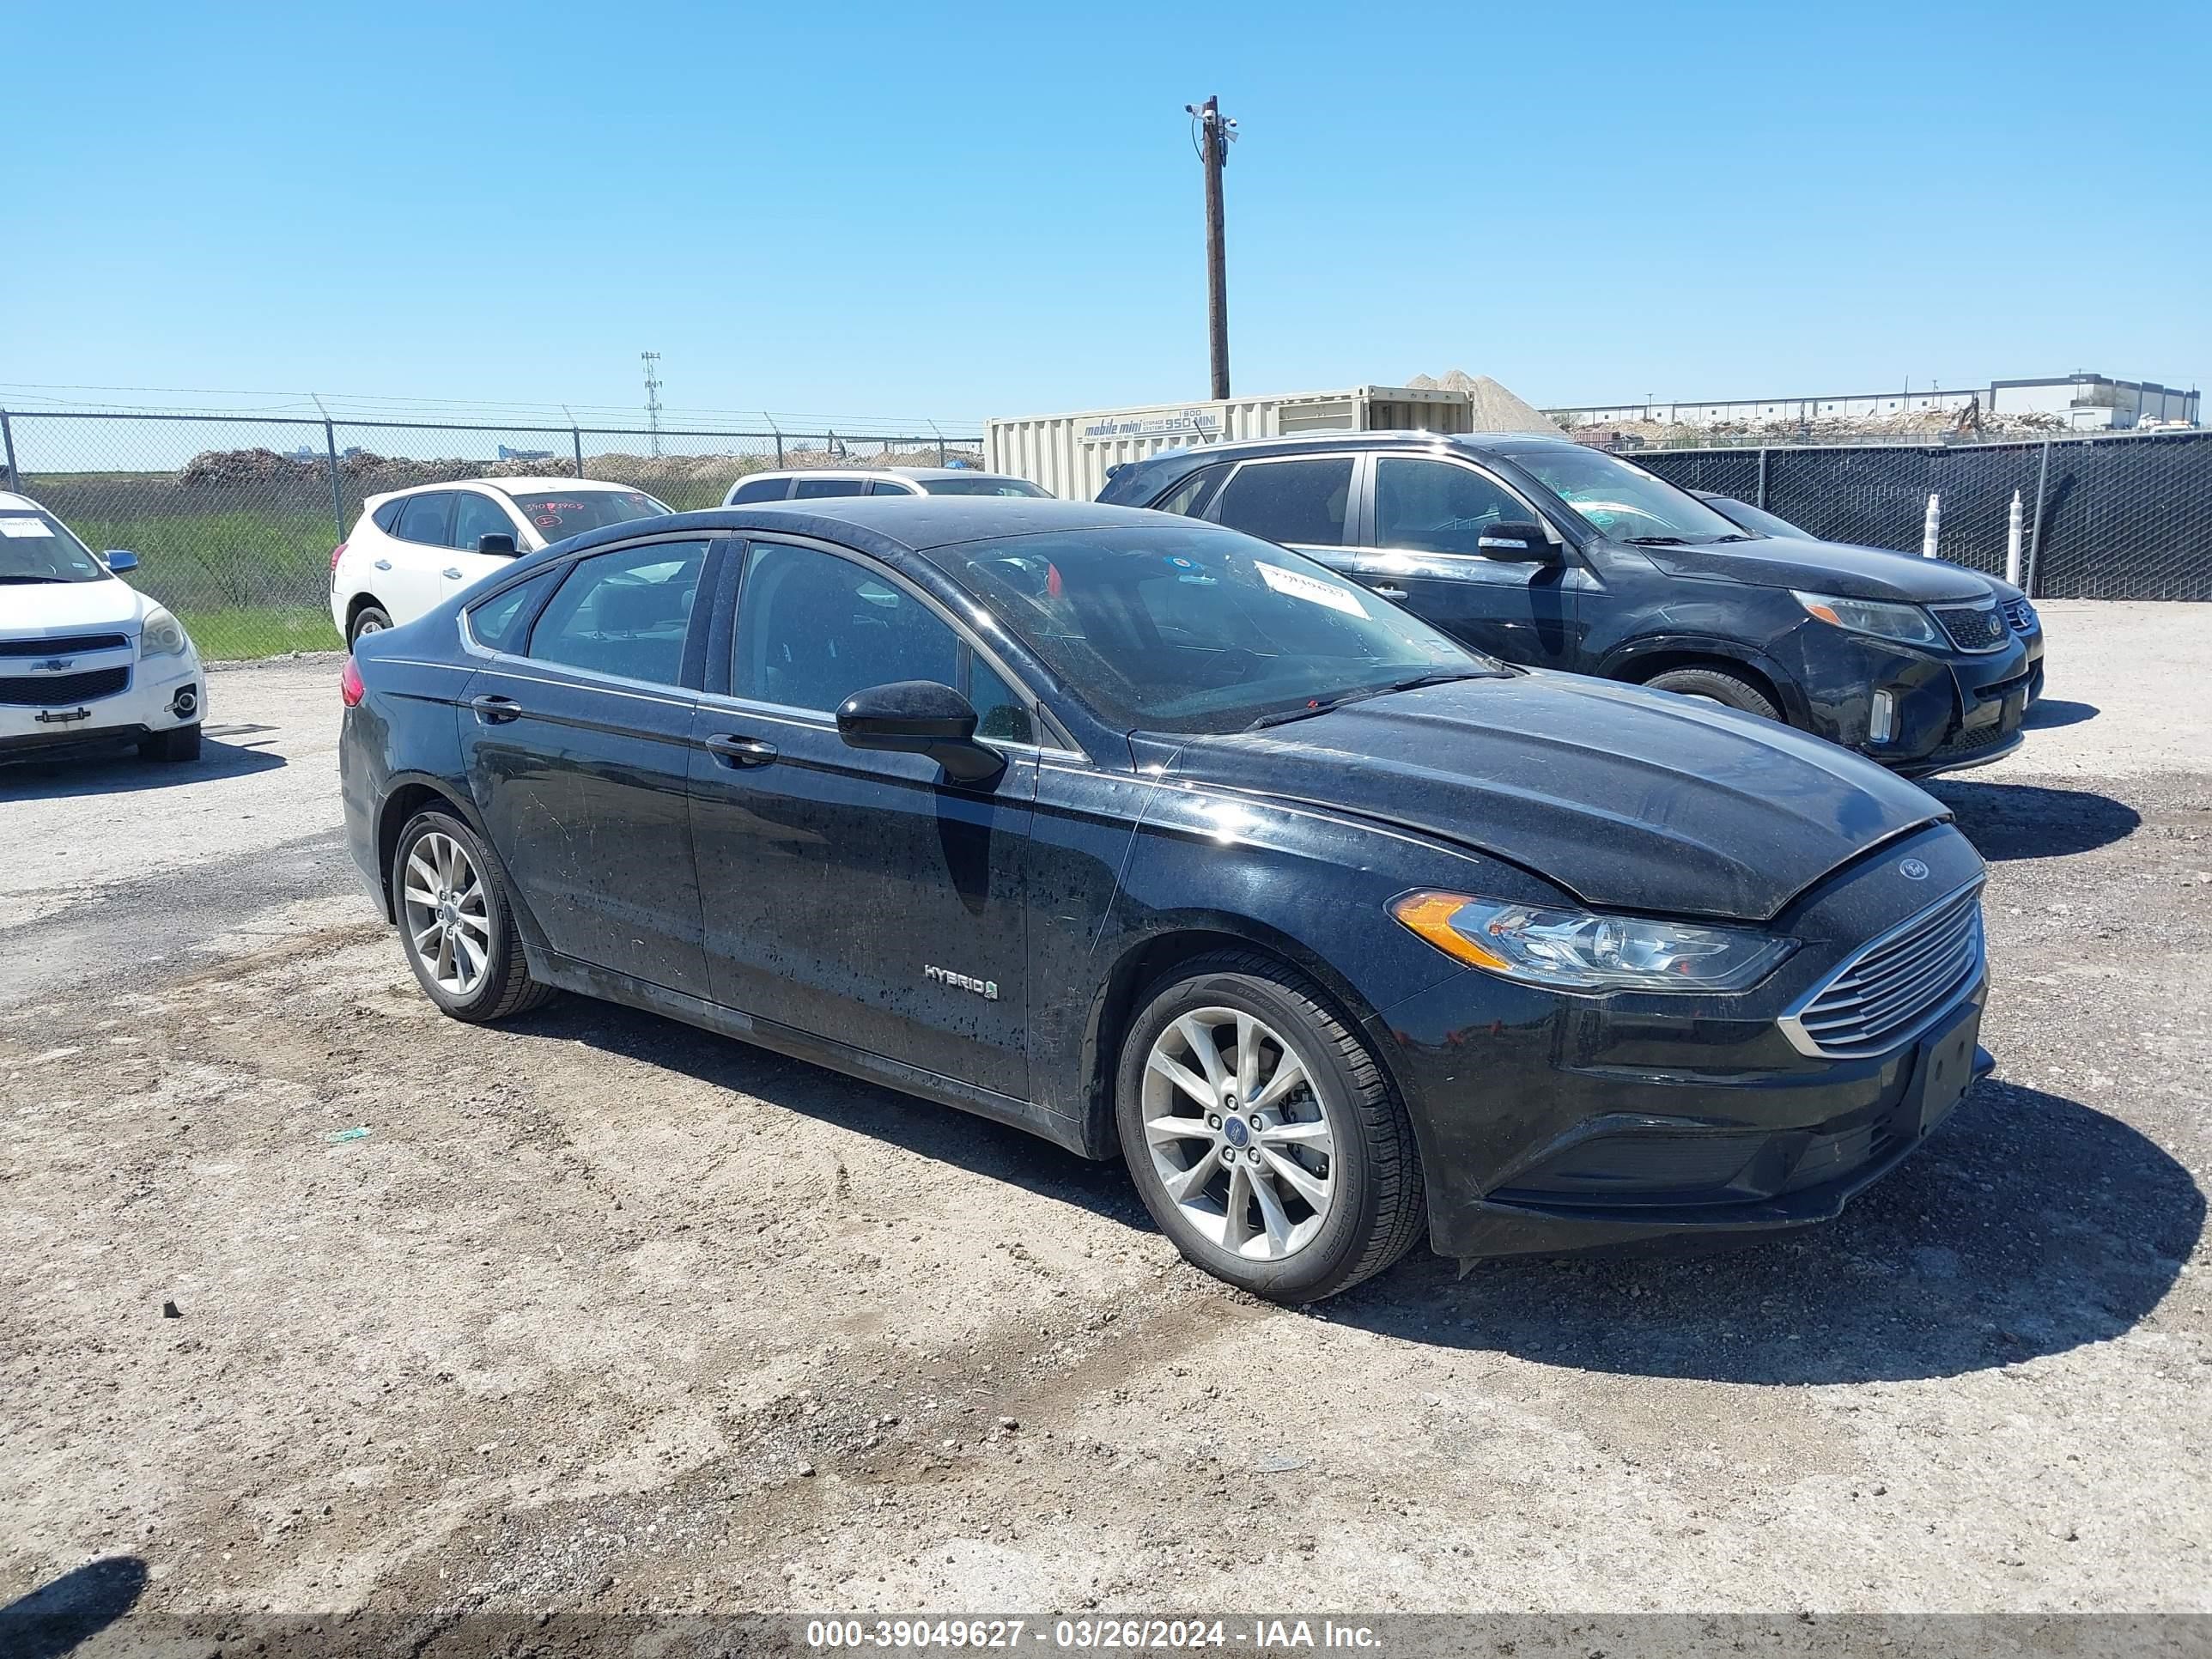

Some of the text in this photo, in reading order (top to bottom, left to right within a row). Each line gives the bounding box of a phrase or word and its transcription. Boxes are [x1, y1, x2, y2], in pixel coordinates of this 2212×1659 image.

[1085, 418, 1143, 436] mobile mini
[924, 964, 985, 994] HYBRID
